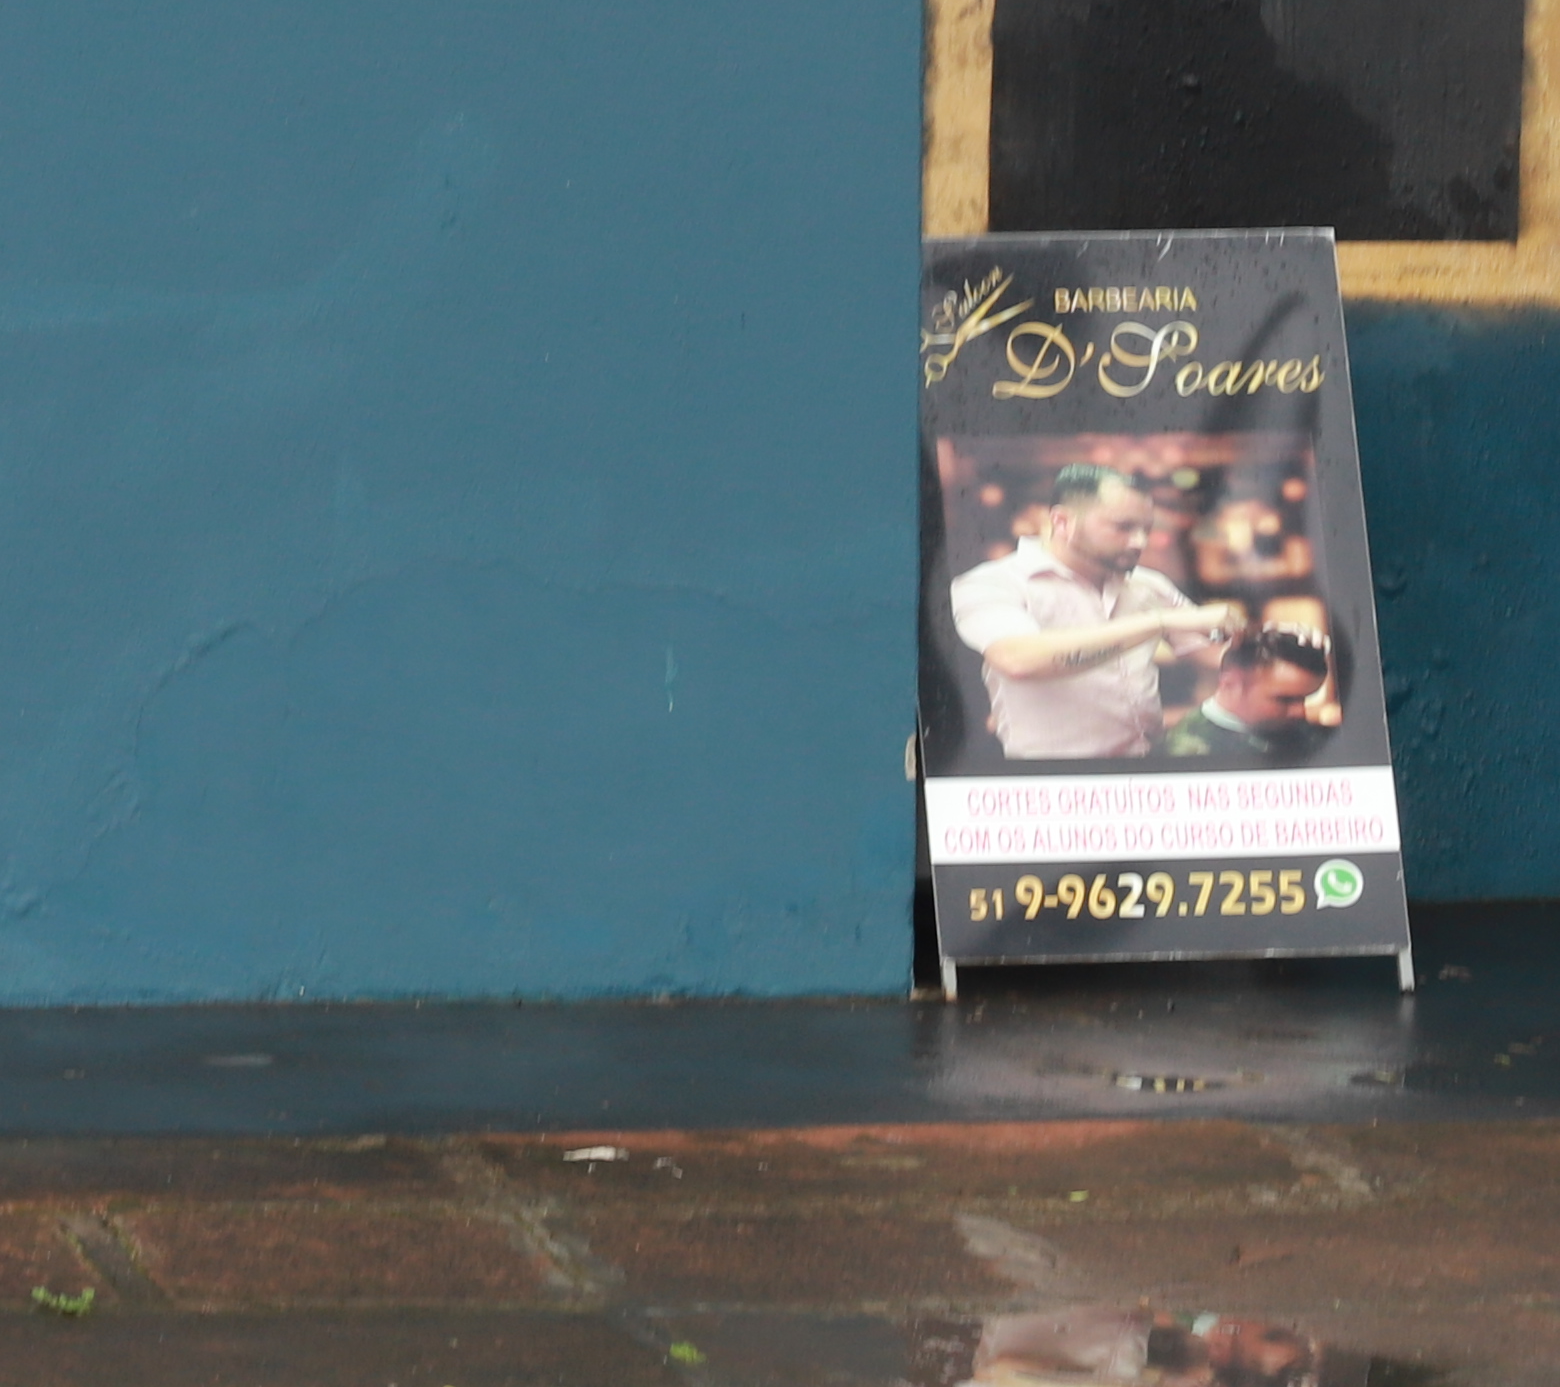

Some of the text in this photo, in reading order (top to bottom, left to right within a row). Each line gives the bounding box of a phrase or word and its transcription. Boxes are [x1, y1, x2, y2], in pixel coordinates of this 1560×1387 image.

[1054, 285, 1197, 314] BARBEARIA
[992, 320, 1326, 400] D'Soares
[966, 785, 1051, 818] CORTES
[1186, 782, 1230, 813] NAS
[1237, 778, 1354, 812] SEGUNDAS
[943, 814, 1384, 854] COM OS ALUNOS DO CURSO DE BARBEIRO
[969, 868, 1306, 921] 51 9-9629.7255
